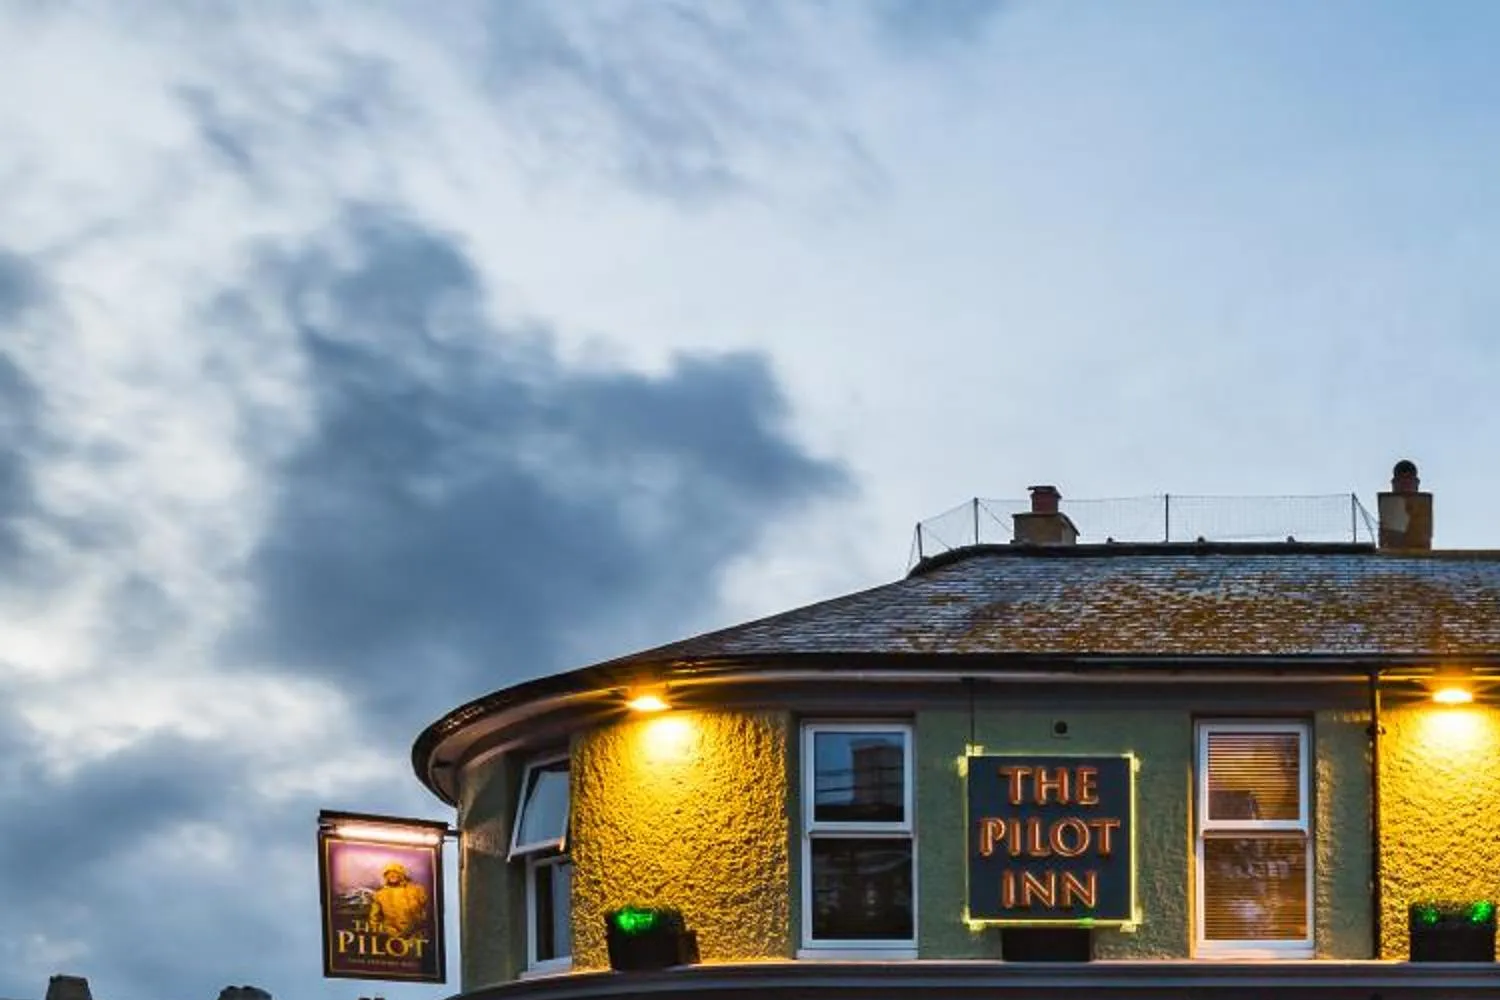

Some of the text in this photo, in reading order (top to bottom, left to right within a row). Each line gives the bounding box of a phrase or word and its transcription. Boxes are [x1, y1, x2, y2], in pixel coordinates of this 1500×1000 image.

[998, 765, 1099, 806] THE
[979, 816, 1121, 858] PILOT
[1002, 869, 1097, 909] INN
[336, 928, 430, 958] PILOT
